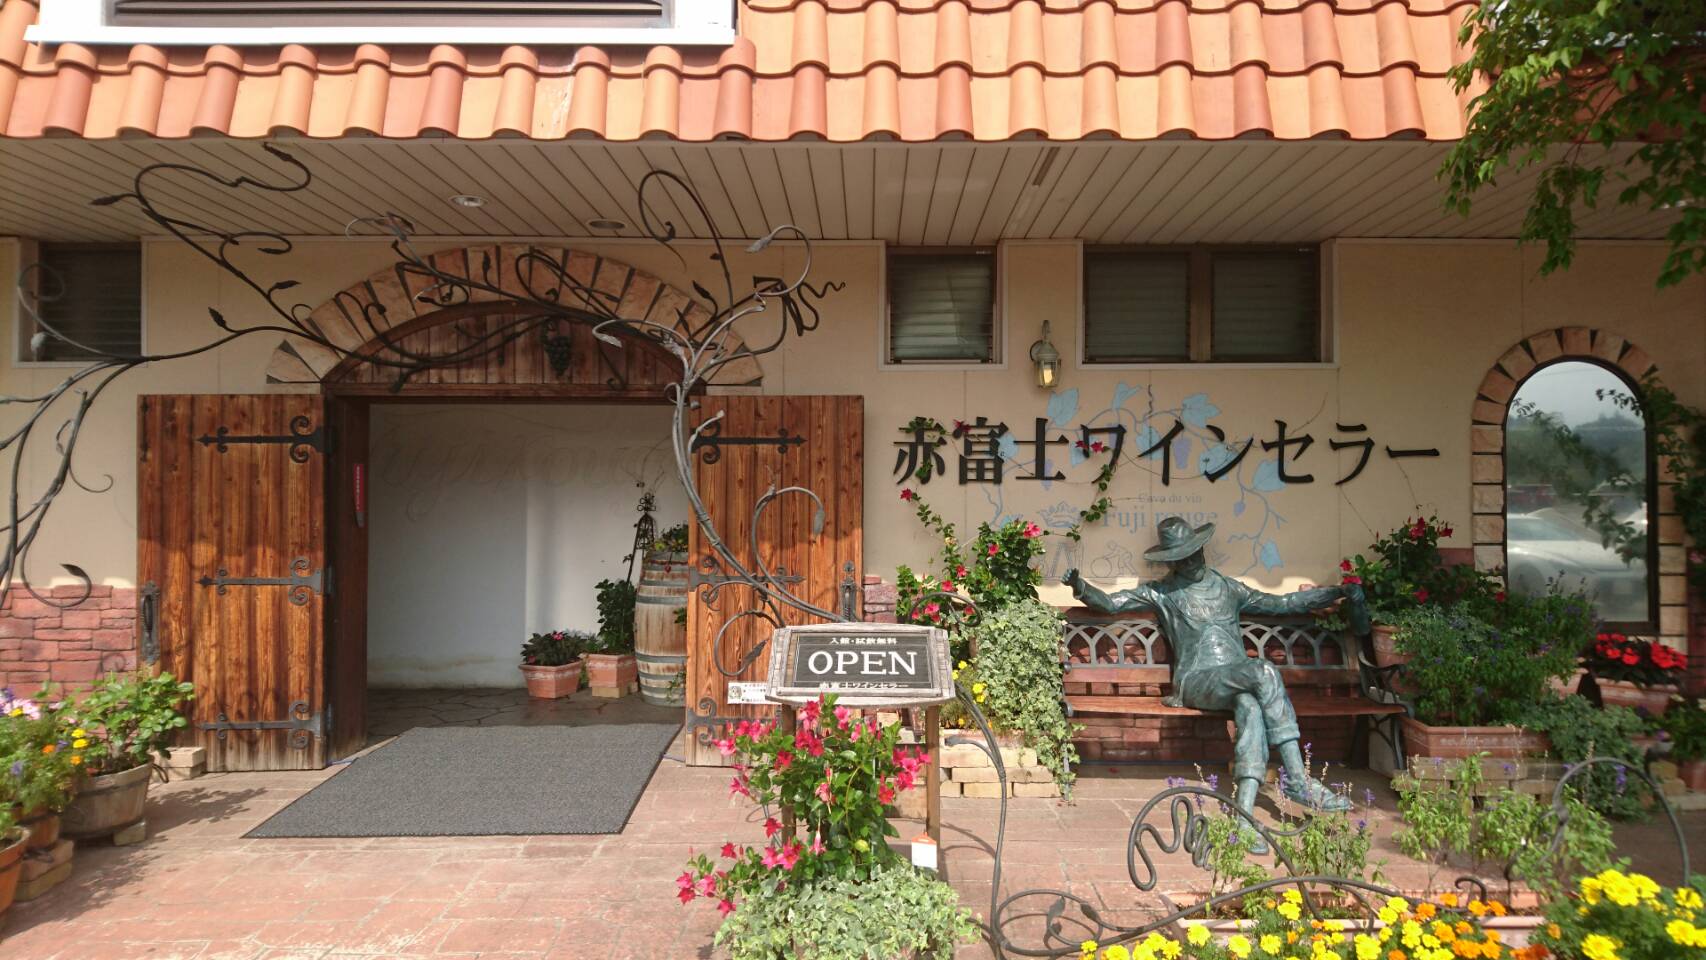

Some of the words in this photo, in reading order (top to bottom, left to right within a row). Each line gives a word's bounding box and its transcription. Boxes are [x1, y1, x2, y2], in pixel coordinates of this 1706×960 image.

[893, 416, 1441, 487] 赤富士ワインセラー
[1100, 506, 1147, 534] Fuji
[808, 650, 918, 675] OPEN
